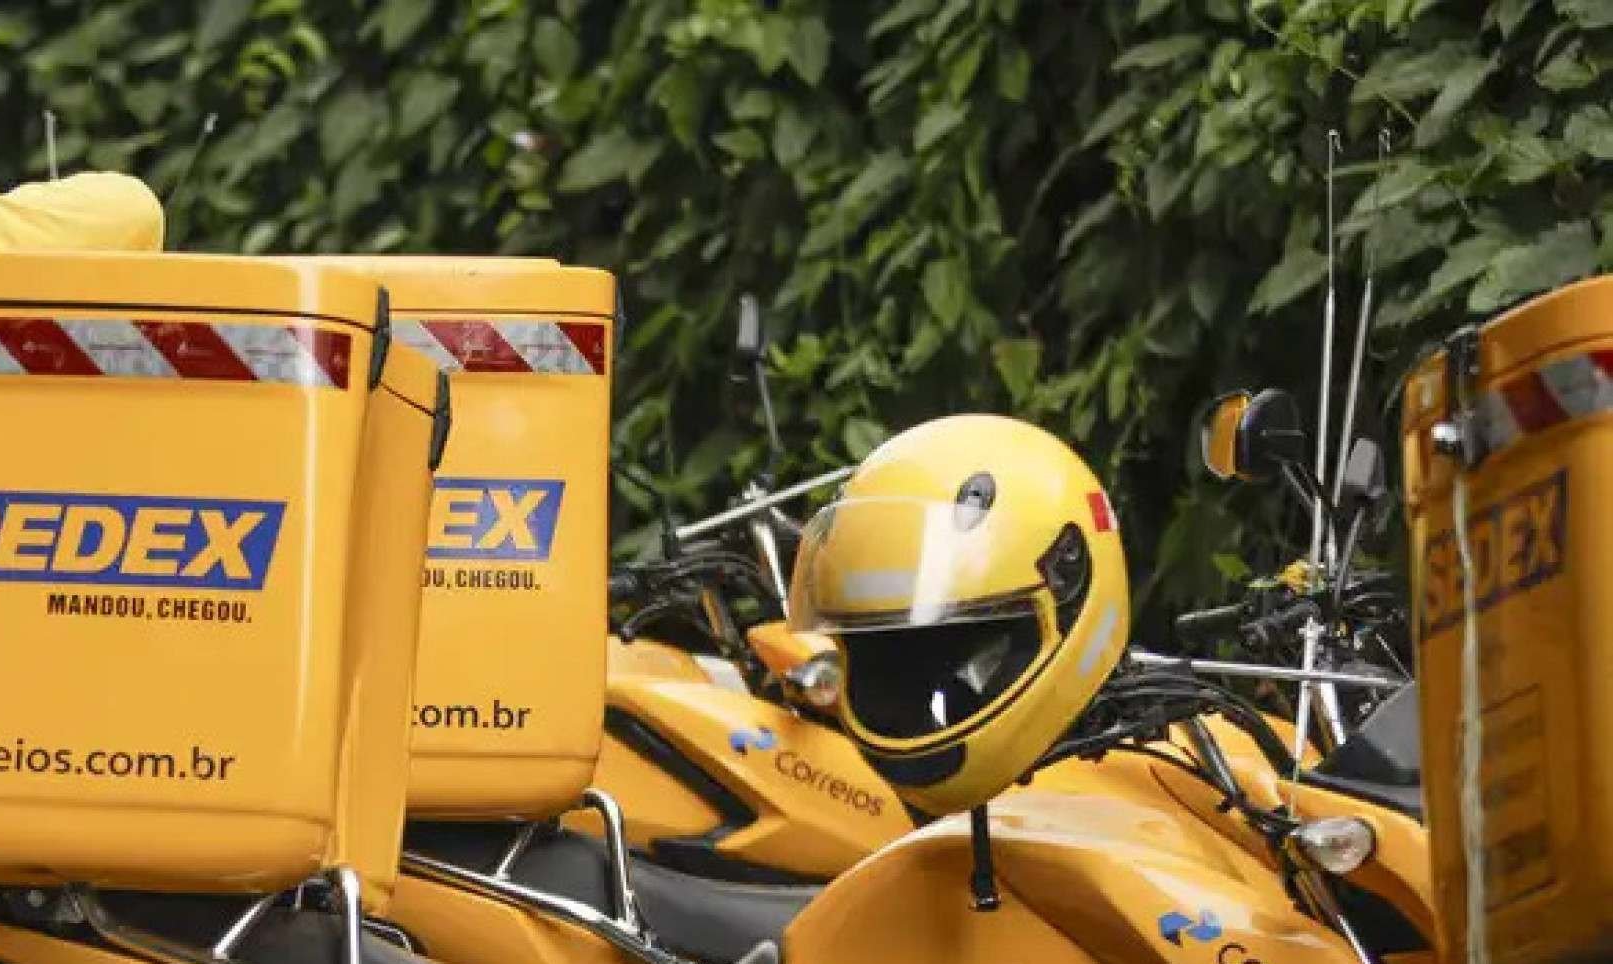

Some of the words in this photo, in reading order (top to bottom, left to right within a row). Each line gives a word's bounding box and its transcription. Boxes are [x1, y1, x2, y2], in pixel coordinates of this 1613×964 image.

[428, 488, 549, 549] EX
[456, 569, 541, 591] CHEGOU.
[157, 597, 252, 624] CHEGOU.
[775, 751, 883, 816] Correios
